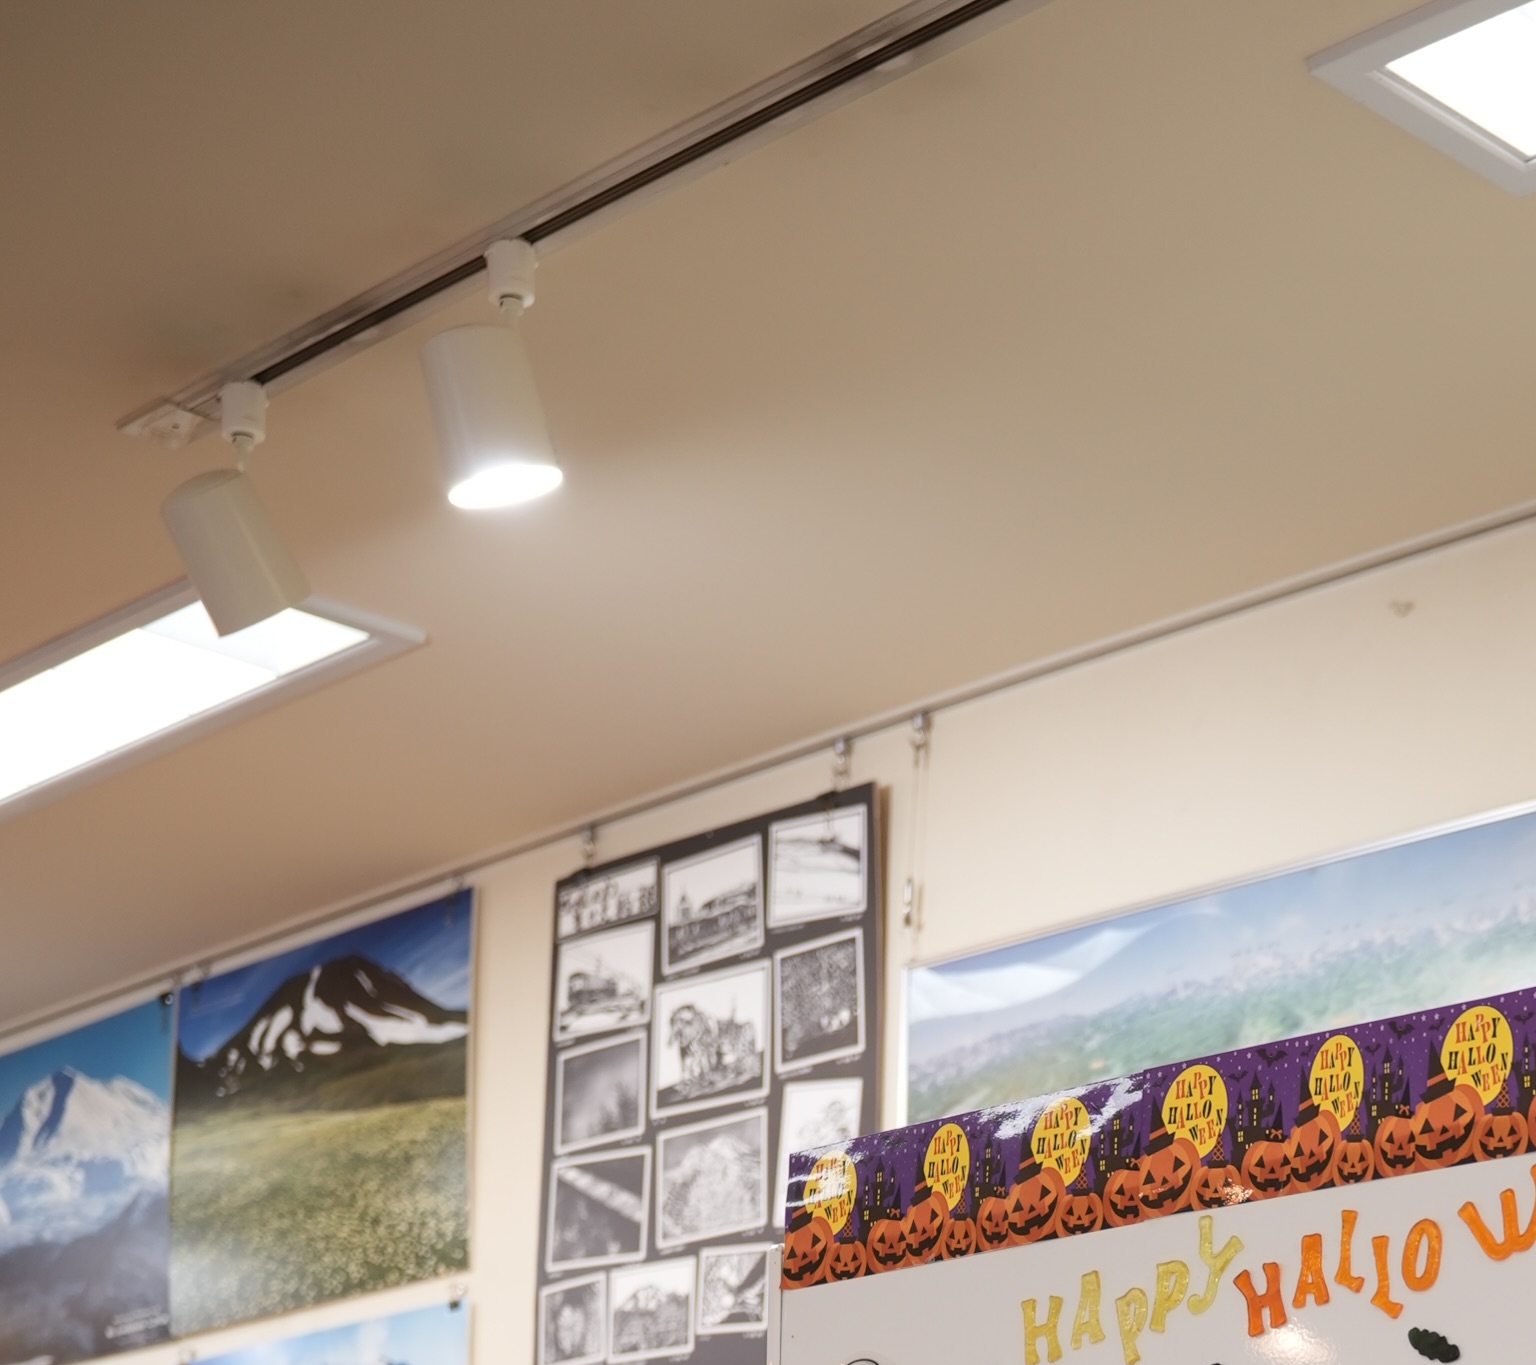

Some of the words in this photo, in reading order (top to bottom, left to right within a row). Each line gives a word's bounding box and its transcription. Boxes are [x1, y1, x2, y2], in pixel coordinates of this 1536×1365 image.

[1455, 1017, 1500, 1044] HAPPY
[1320, 1046, 1353, 1071] HAPPY
[1176, 1075, 1216, 1101] HAPPY
[1044, 1103, 1081, 1130] HAPPY
[934, 1130, 962, 1157] HAPPY
